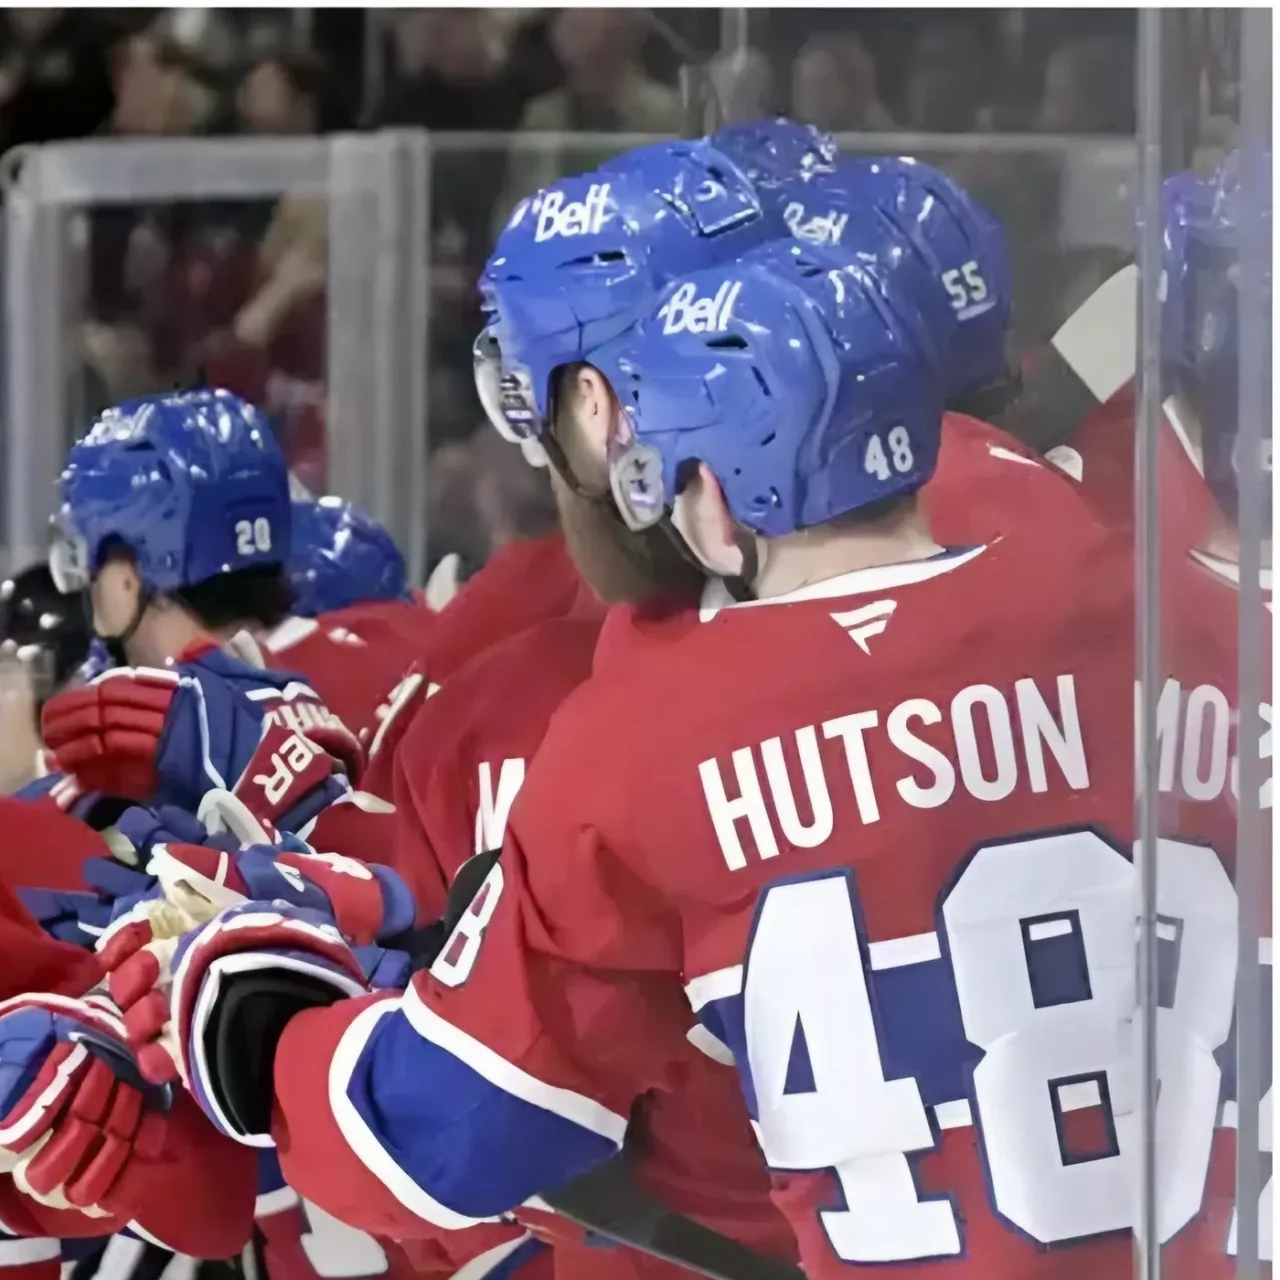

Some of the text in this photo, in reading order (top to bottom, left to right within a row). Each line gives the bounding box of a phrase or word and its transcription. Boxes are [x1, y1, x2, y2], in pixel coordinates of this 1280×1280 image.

[534, 183, 613, 242] Bell
[658, 280, 743, 335] Bell
[942, 261, 987, 309] 55
[865, 427, 913, 481] 48
[235, 517, 271, 555] 20
[697, 673, 1091, 873] HUTSON
[742, 826, 1240, 1264] 48
